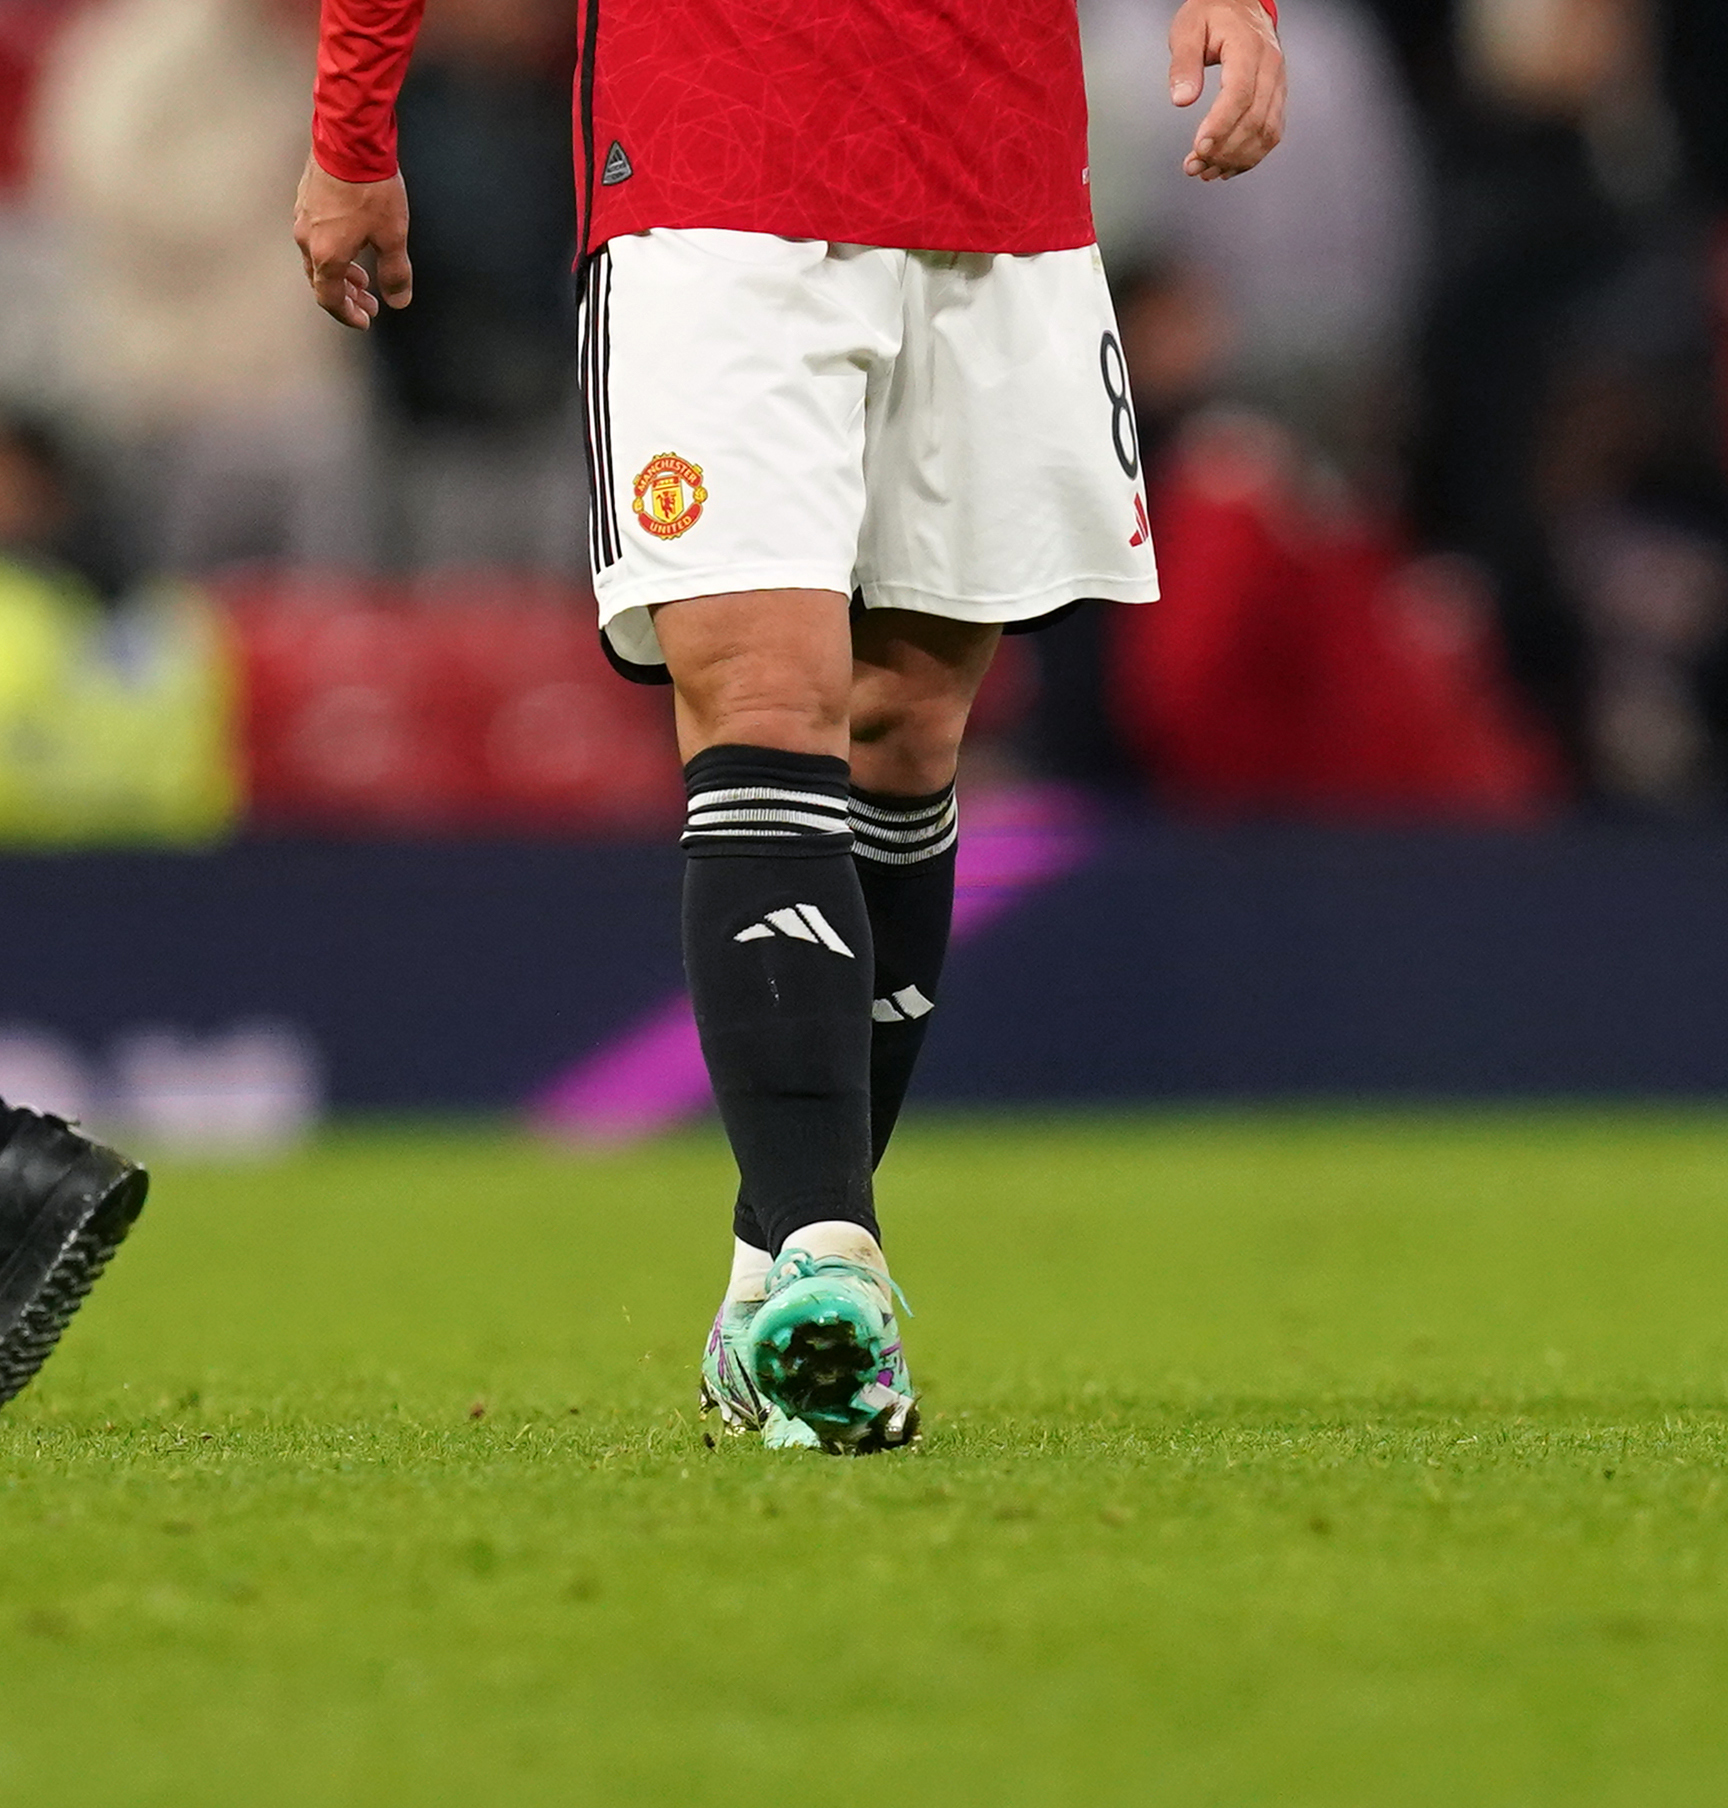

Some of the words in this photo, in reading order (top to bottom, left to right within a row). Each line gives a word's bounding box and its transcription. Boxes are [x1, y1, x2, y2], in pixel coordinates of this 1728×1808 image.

[1099, 328, 1139, 481] 8
[636, 458, 698, 492] MANCHESTER
[648, 515, 693, 535] UNITED
